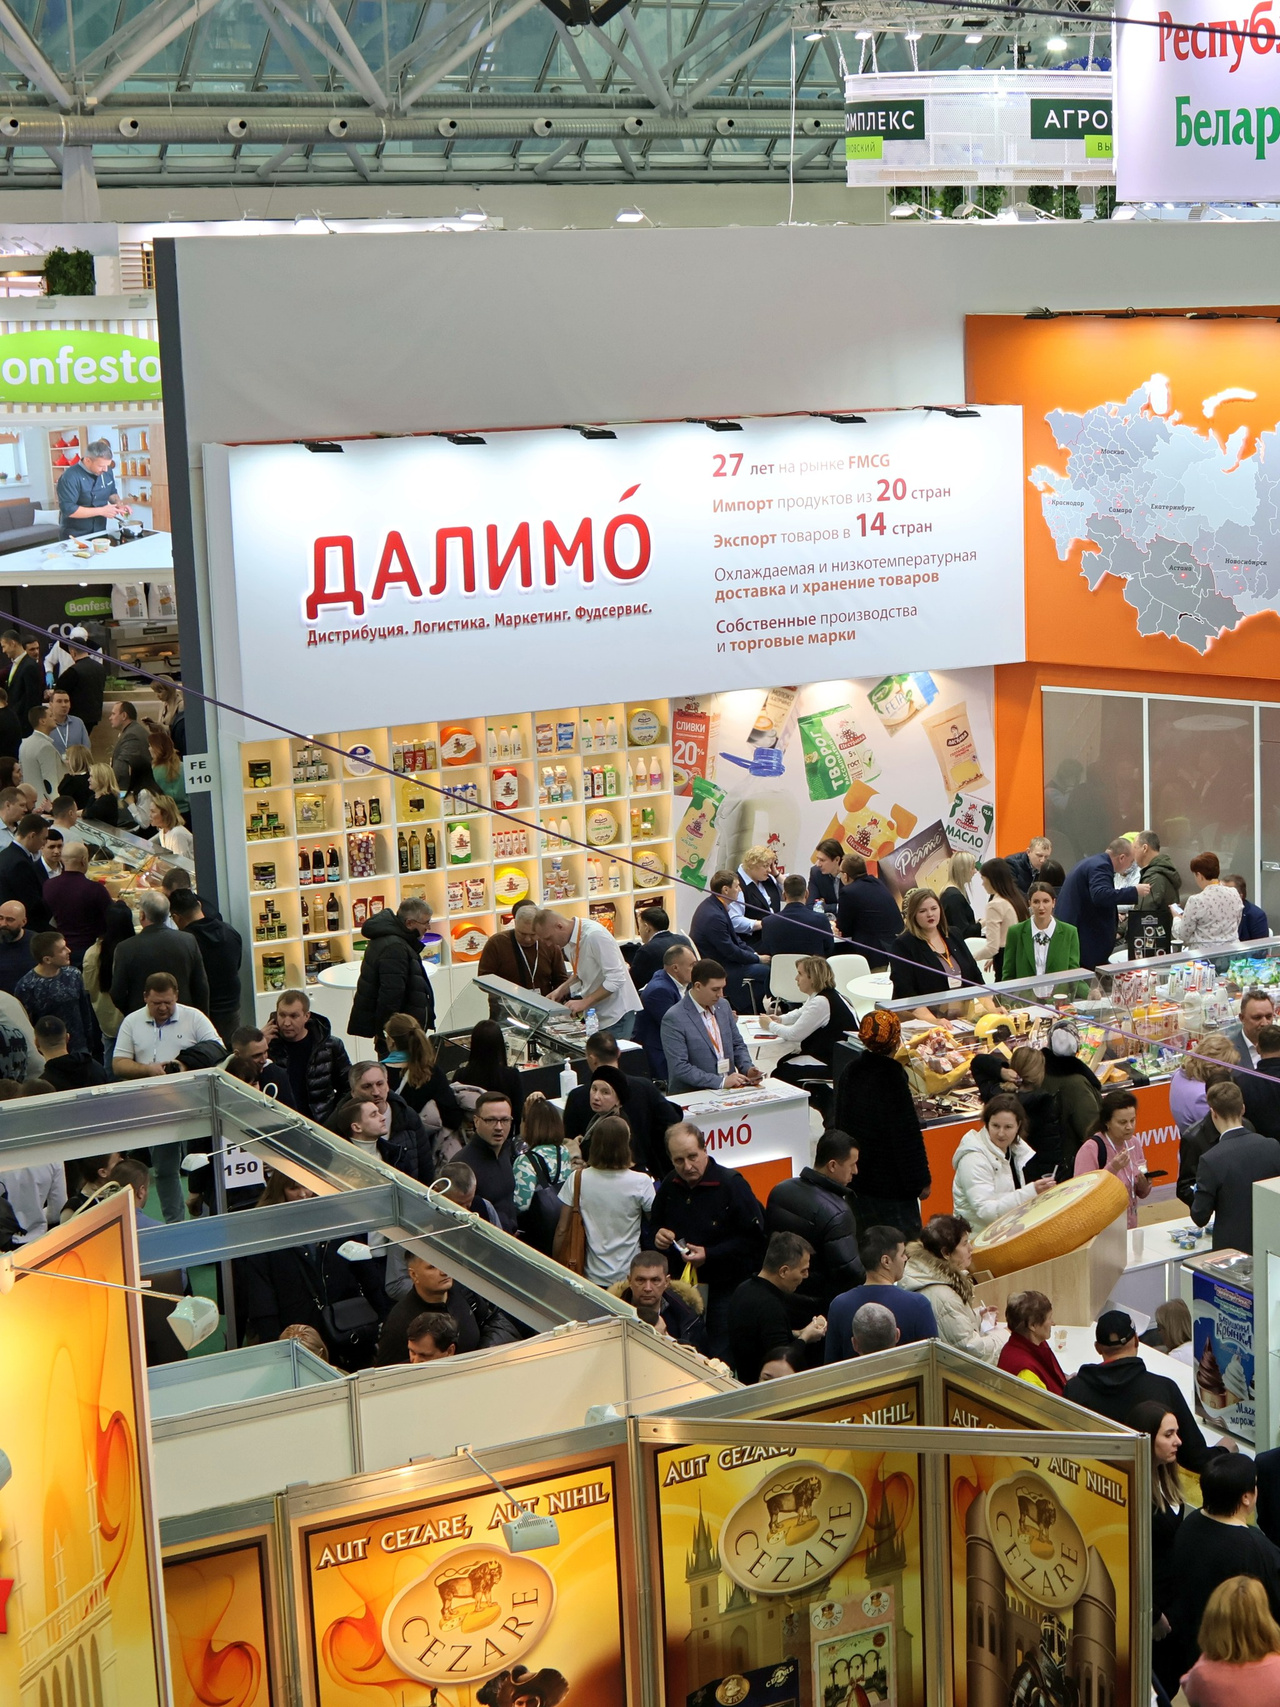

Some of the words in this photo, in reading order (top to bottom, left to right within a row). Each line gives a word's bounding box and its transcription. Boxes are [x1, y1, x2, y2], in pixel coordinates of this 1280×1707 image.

[1044, 110, 1112, 129] АГРО
[1101, 448, 1125, 456] Москва
[713, 453, 744, 477] 27
[750, 463, 775, 475] лет
[779, 462, 795, 473] на
[799, 459, 845, 475] рынке
[848, 454, 890, 470] FMCG
[713, 498, 773, 513] Импорт
[777, 492, 853, 510] продуктов
[856, 492, 872, 503] из
[876, 478, 907, 502] 20
[911, 487, 951, 502] стран
[1051, 499, 1085, 508] Краснодар
[1150, 503, 1195, 512] Екатеринбург
[713, 533, 777, 548] Экспорт
[781, 529, 839, 544] товаров
[843, 527, 850, 538] в
[856, 512, 886, 537] 14
[892, 522, 932, 537] стран
[714, 564, 815, 582] Охлаждаемая
[818, 562, 828, 573] и
[831, 550, 977, 573] низкотемпературная
[1225, 557, 1268, 567] Новосибирск
[715, 585, 786, 603] доставка
[790, 583, 799, 594] и
[802, 576, 875, 594] хранение
[878, 570, 940, 587] товаров
[70, 601, 111, 614] Bonfest
[716, 614, 816, 634] Собственные
[820, 605, 918, 627] производства
[307, 623, 409, 647] Дистрибуция.
[413, 616, 491, 635] Логистика.
[494, 607, 571, 628] Маркетинг.
[575, 601, 653, 622] Фудсервис.
[717, 641, 726, 652] и
[730, 634, 804, 654] торговые
[807, 628, 856, 646] марки
[884, 692, 907, 715] FETA
[675, 720, 706, 733] СЛИВКИ
[673, 740, 705, 765] 20%
[809, 731, 845, 791] ТВОРОГ
[847, 759, 860, 769] ГОСТ
[190, 760, 207, 770] FE
[188, 775, 212, 785] 110
[944, 824, 984, 848] МАСЛО
[224, 1160, 258, 1177] 150
[862, 1403, 915, 1426] NIHIL
[952, 1408, 981, 1428] AUT
[663, 1454, 710, 1488] AUT
[1049, 1456, 1080, 1484] AUT
[1085, 1470, 1127, 1507] NIHIL
[316, 1537, 370, 1570] AUT
[380, 1513, 473, 1552] CEZARE,
[488, 1497, 539, 1529] AUT
[548, 1482, 609, 1516] NIHIL
[734, 1501, 853, 1584] CEZARE
[996, 1510, 1080, 1598] CEZARE
[812, 1608, 843, 1629] CEZARE
[863, 1597, 890, 1617] CEZARE
[401, 1587, 539, 1673] CEZARE
